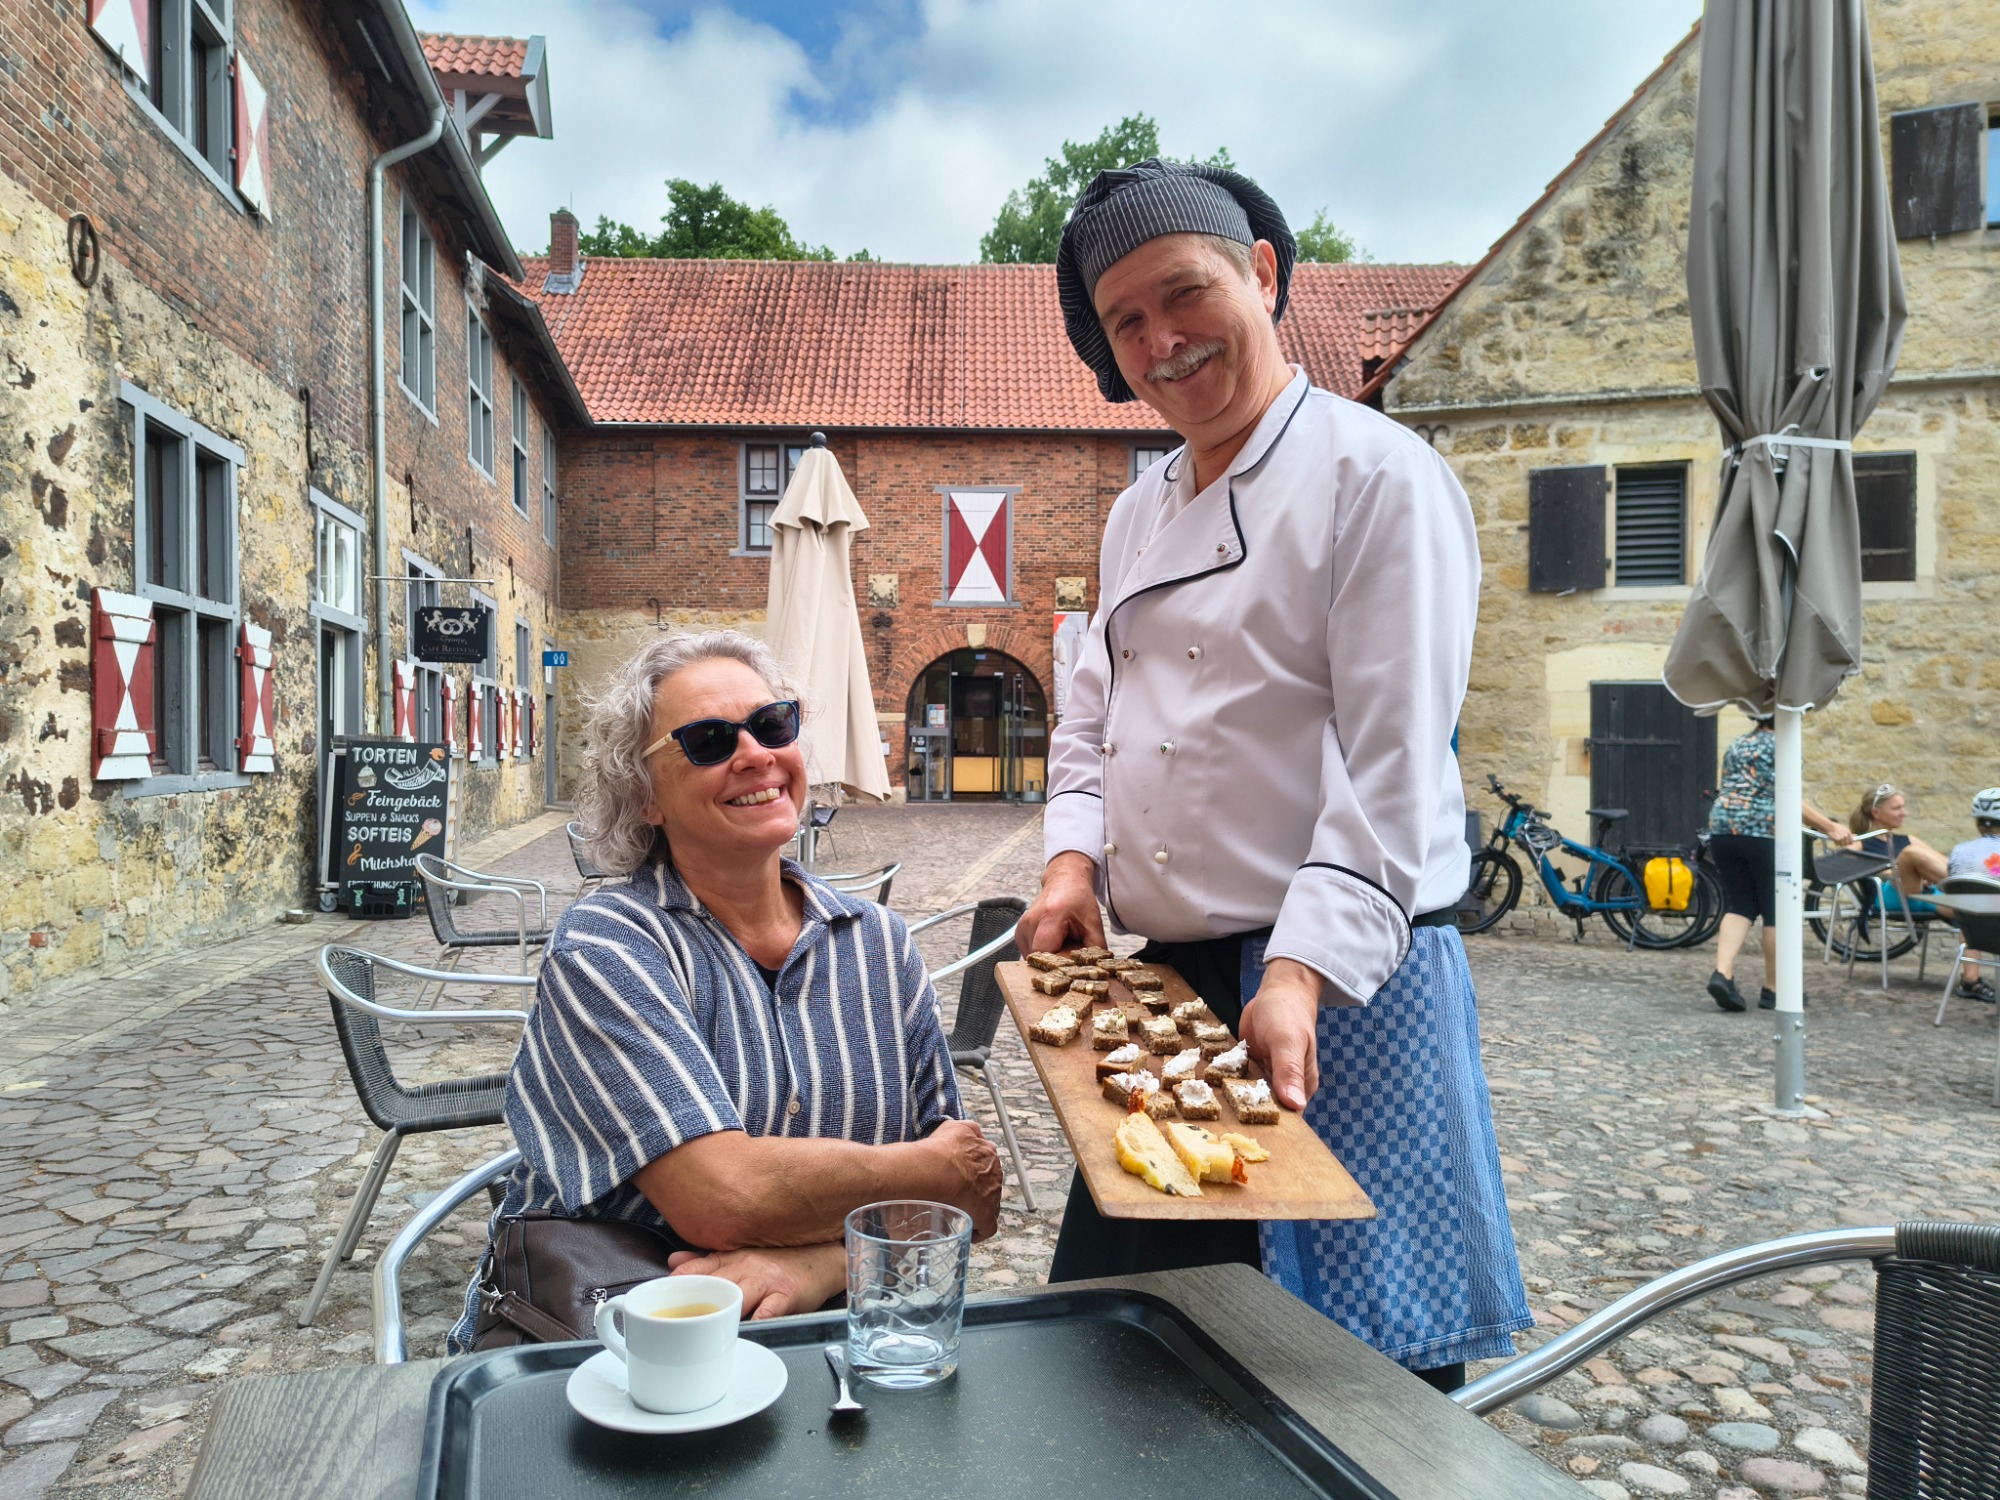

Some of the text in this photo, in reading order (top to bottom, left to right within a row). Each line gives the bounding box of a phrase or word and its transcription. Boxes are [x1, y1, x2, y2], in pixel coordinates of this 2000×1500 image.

[352, 747, 417, 764] TORTEN
[367, 790, 442, 812] Feingebäck
[345, 811, 420, 823] SUPPEN & SNACKS
[347, 826, 412, 843] SOFTEIS
[360, 856, 416, 871] Milchsha
